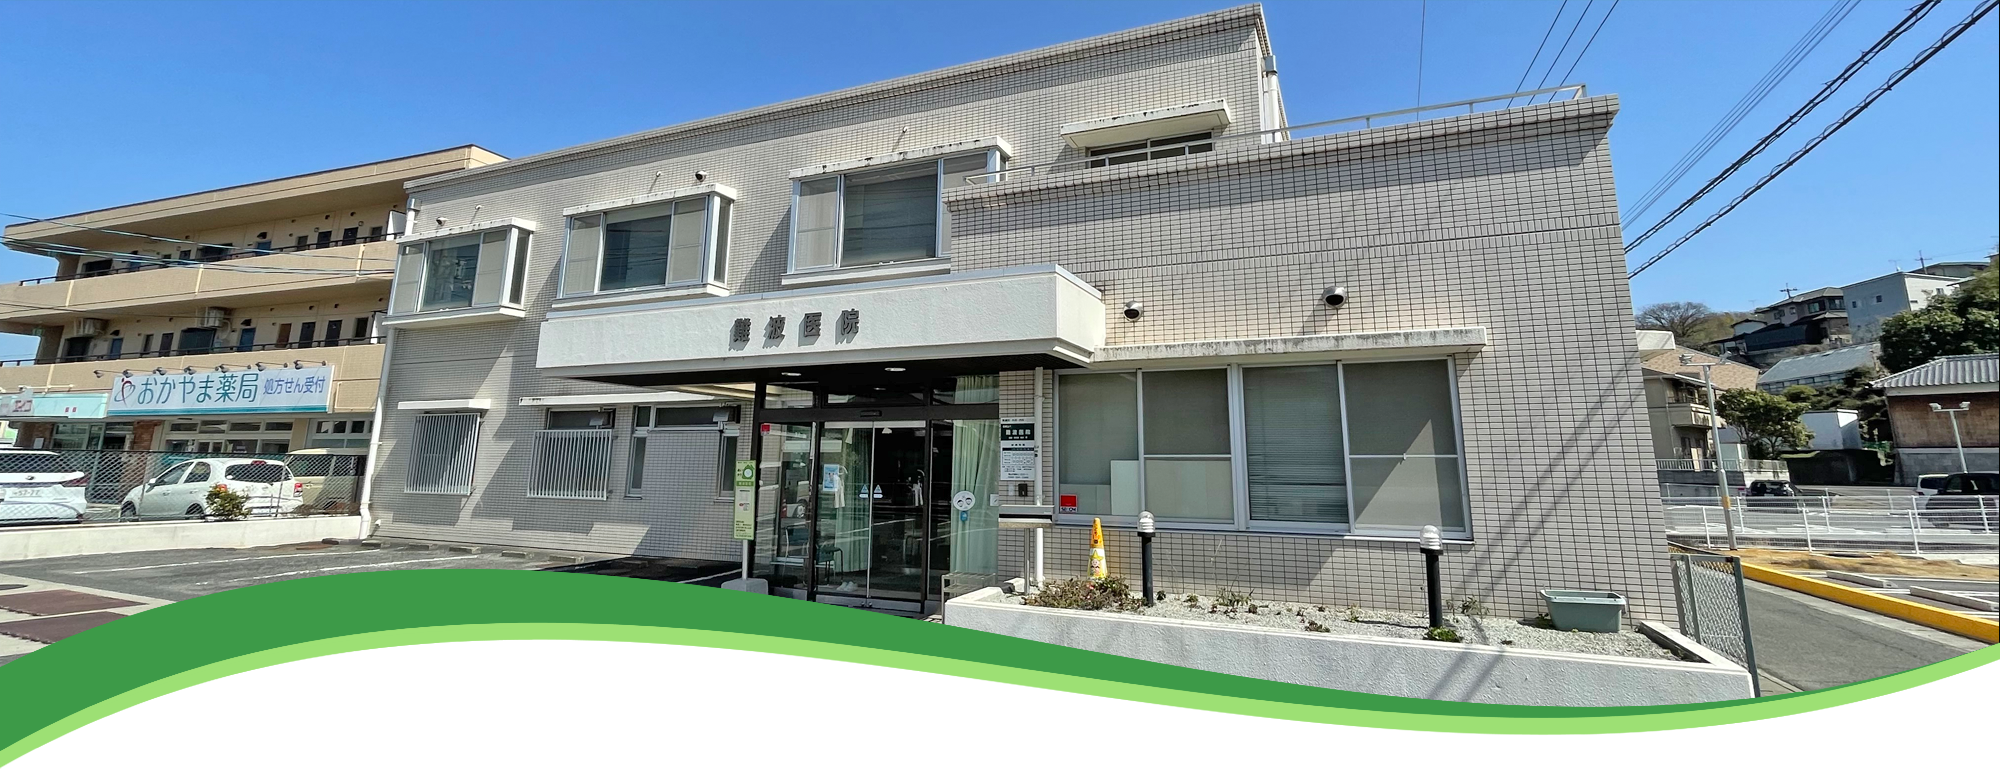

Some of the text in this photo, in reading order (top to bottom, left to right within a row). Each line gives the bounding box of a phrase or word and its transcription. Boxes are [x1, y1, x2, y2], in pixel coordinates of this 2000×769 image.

[733, 309, 860, 342] 難波医院
[138, 373, 326, 405] おかやま薬局 処方せん受付
